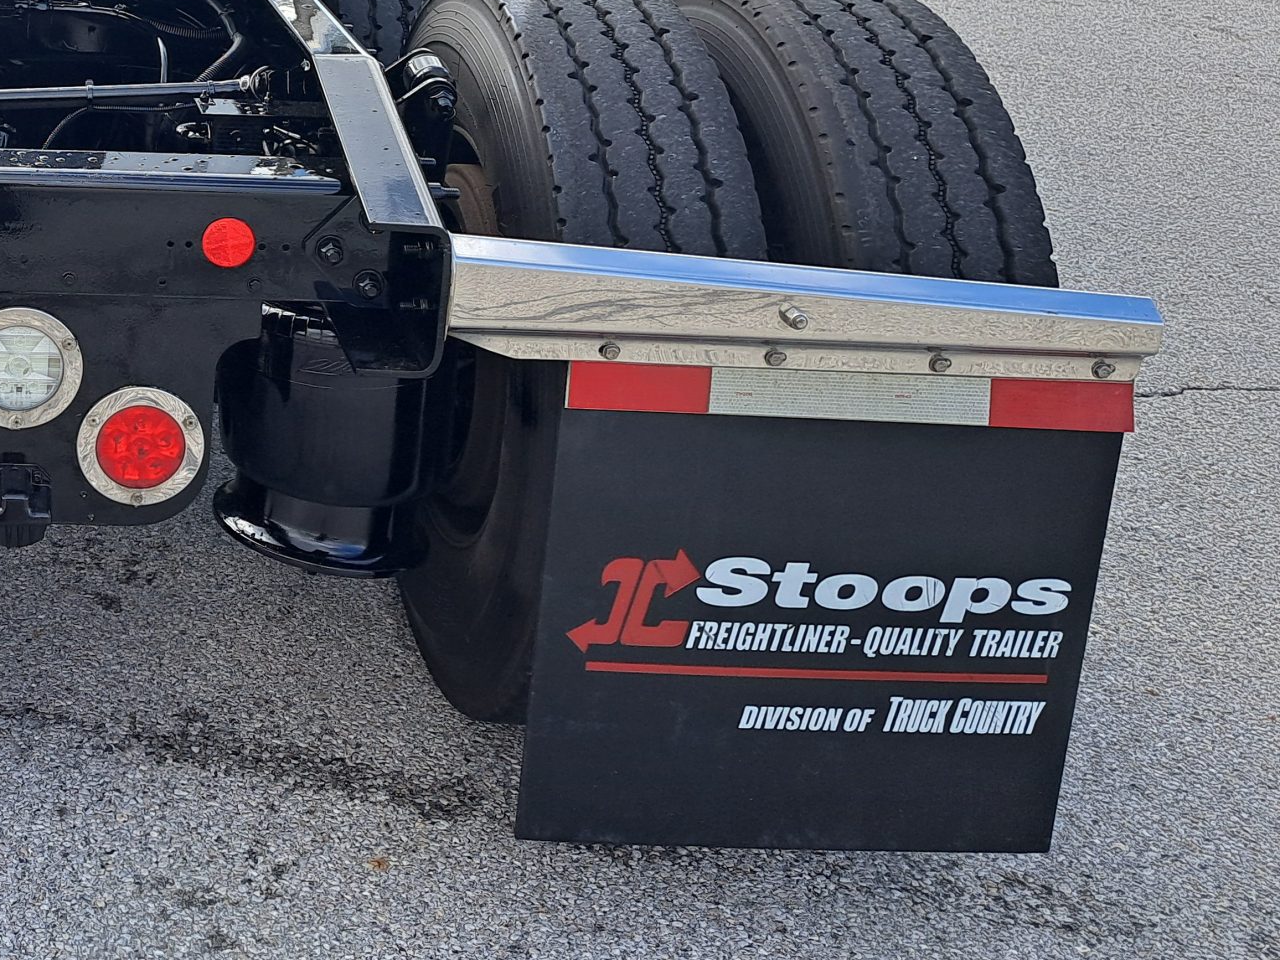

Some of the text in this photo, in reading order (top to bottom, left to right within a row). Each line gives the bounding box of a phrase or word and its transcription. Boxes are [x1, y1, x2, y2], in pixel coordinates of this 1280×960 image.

[695, 556, 1073, 624] Stoops
[969, 629, 1064, 658] TRAILER
[738, 696, 1047, 735] DIVISION OF TRUCK COUNTRY
